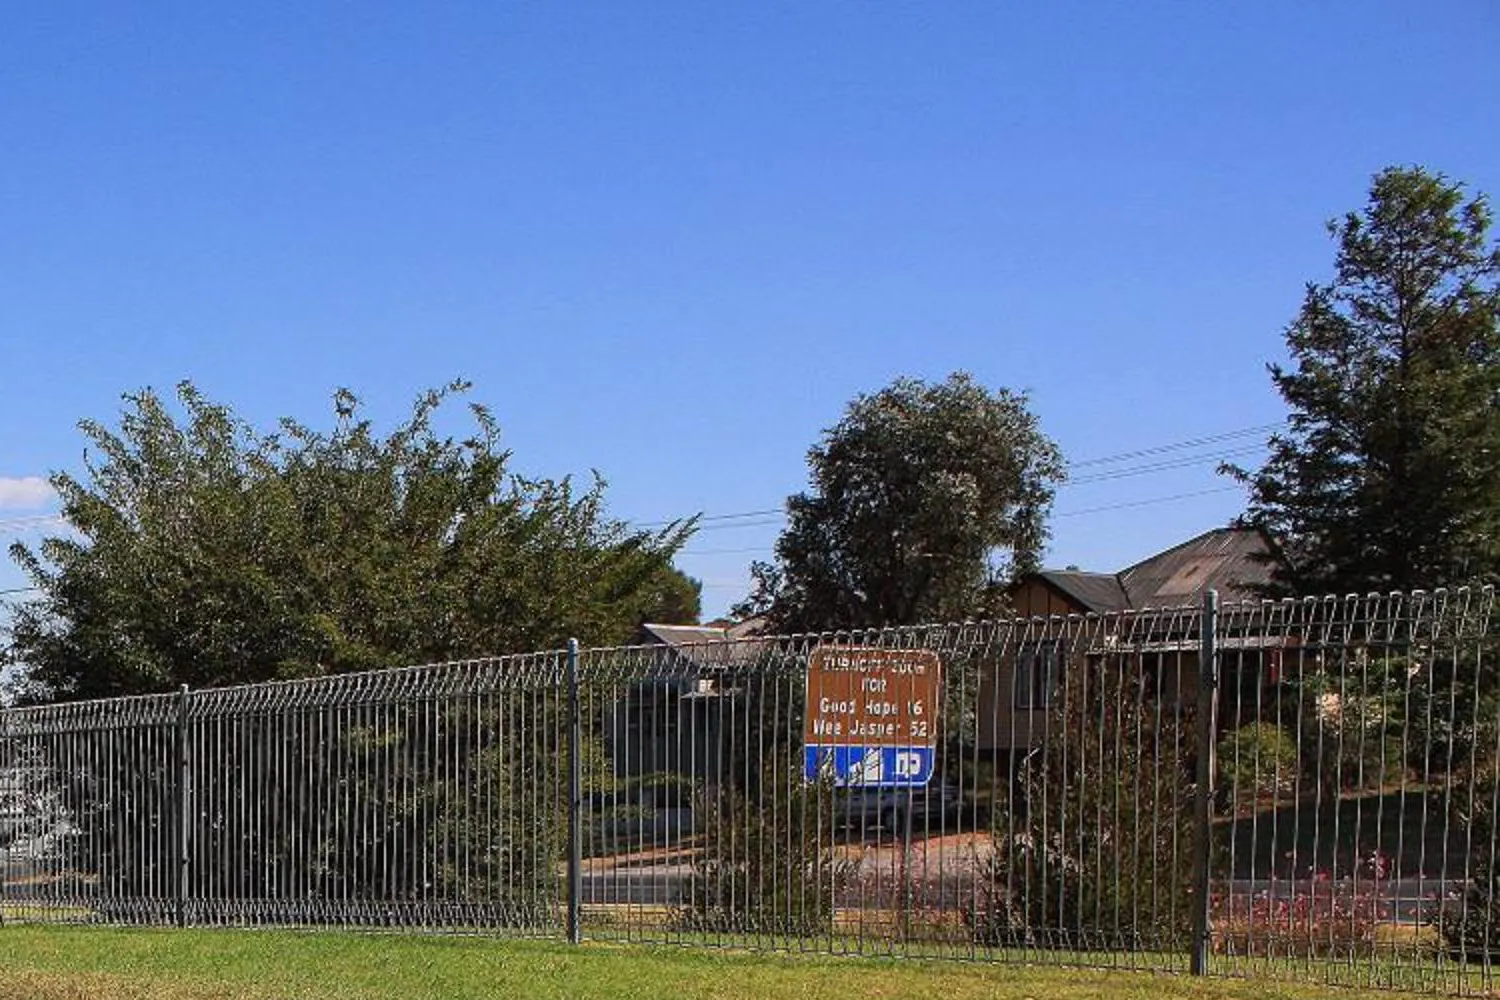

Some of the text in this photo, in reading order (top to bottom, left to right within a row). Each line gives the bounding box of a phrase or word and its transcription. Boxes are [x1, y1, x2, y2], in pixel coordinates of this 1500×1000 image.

[820, 697, 856, 713] Good
[813, 720, 928, 738] Wee Jasper 52
